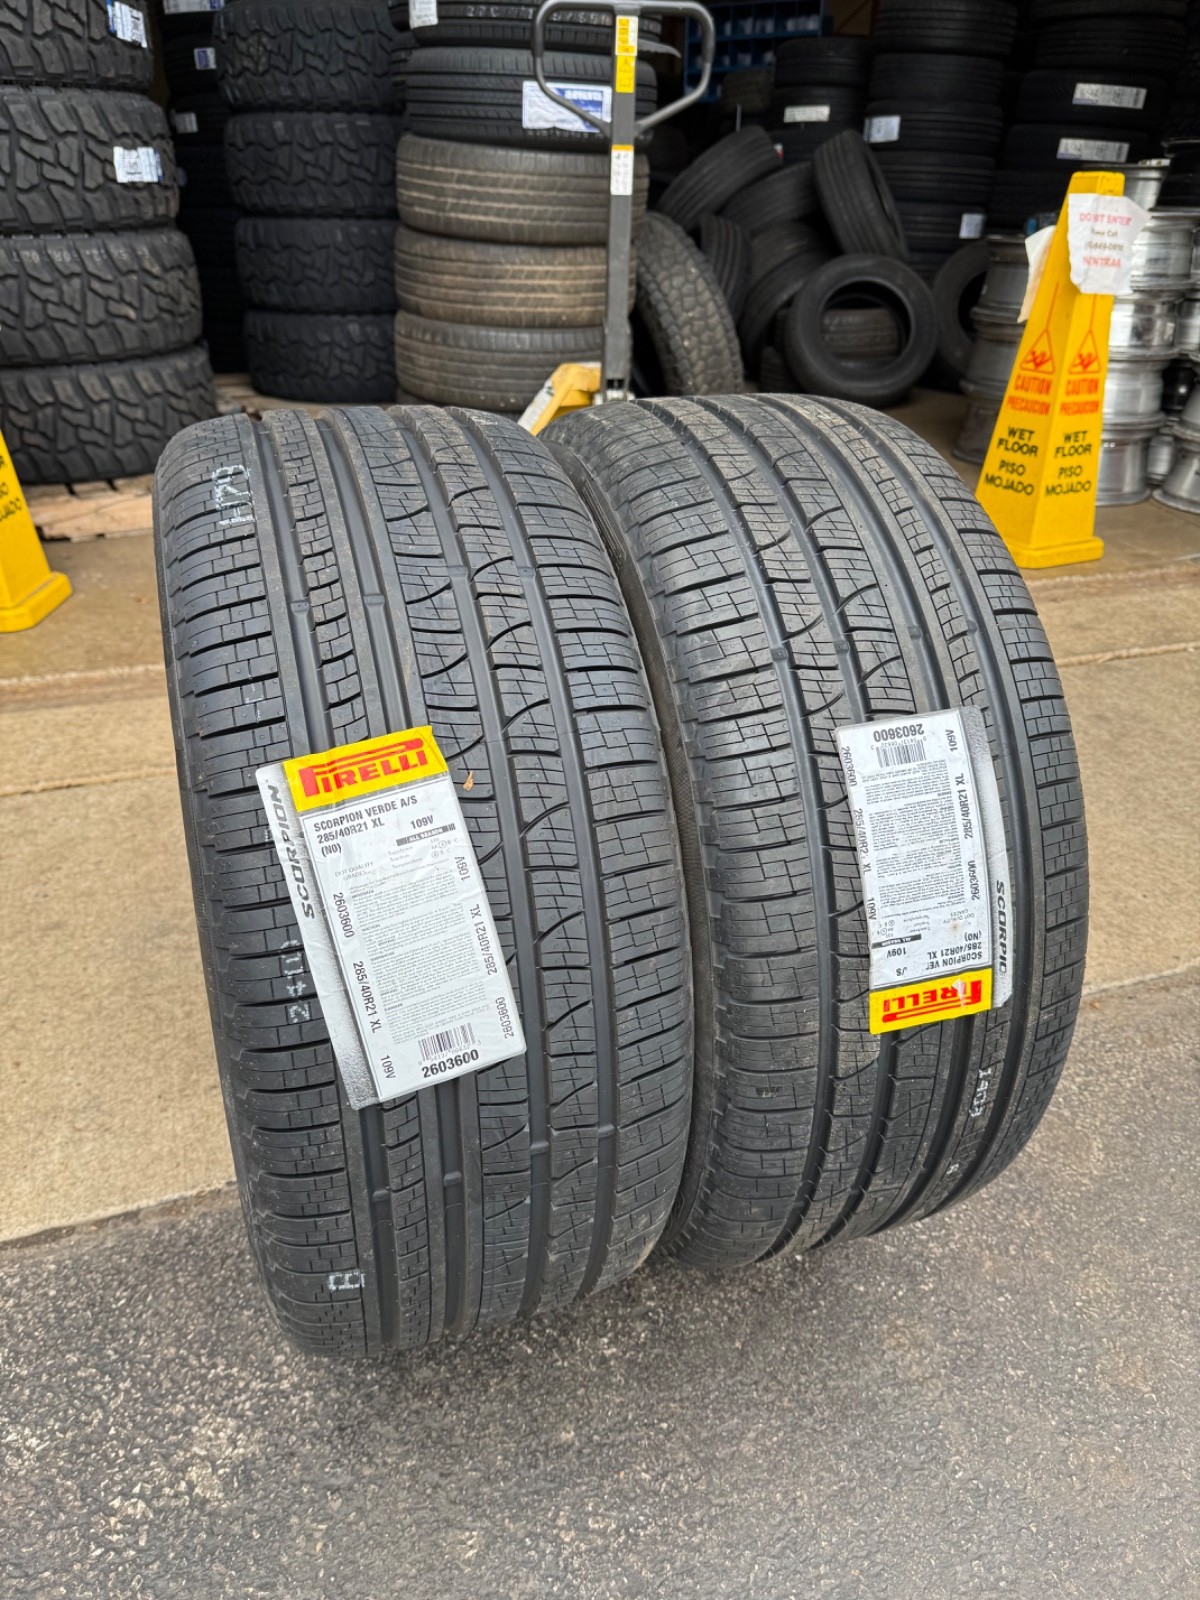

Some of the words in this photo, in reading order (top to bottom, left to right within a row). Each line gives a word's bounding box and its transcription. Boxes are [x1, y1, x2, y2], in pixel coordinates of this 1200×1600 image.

[1014, 374, 1052, 396] CAUTION
[1065, 377, 1099, 397] CAUTION
[1007, 426, 1036, 442] WET
[1062, 430, 1088, 444] WET
[996, 437, 1039, 457] FLOOR
[1054, 444, 1092, 459] FLOOR
[998, 459, 1026, 476] PISO
[1057, 465, 1083, 480] PISO
[984, 473, 1035, 496] MOJADO
[1044, 480, 1092, 498] MOJADO
[873, 723, 925, 742] 2603600
[945, 729, 958, 752] 109V
[298, 738, 428, 798] PIRELLI
[955, 773, 965, 786] XL
[313, 811, 363, 833] SCORPION
[364, 800, 398, 818] VERDE
[400, 795, 418, 808] A/S
[411, 815, 434, 830] 109V
[957, 789, 974, 839] 285/40R21
[317, 822, 369, 844] 285/40R21
[372, 817, 385, 828] XL
[268, 784, 315, 919] SCORPION
[454, 856, 470, 882] 109V
[333, 892, 355, 938] 2603600
[469, 904, 481, 918] XL
[866, 897, 877, 920] 109V
[474, 921, 497, 975] 285/40R21
[886, 947, 907, 959] 109V
[927, 952, 937, 960] XL
[940, 942, 982, 956] 285/40R21
[942, 951, 982, 967] SCORPION
[353, 960, 378, 1017] 285/40R21
[369, 1018, 382, 1034] XL
[882, 980, 982, 1023] PIRELLI
[495, 997, 514, 1039] 2603600
[380, 1054, 396, 1079] 109V
[421, 1049, 479, 1079] 2603600
